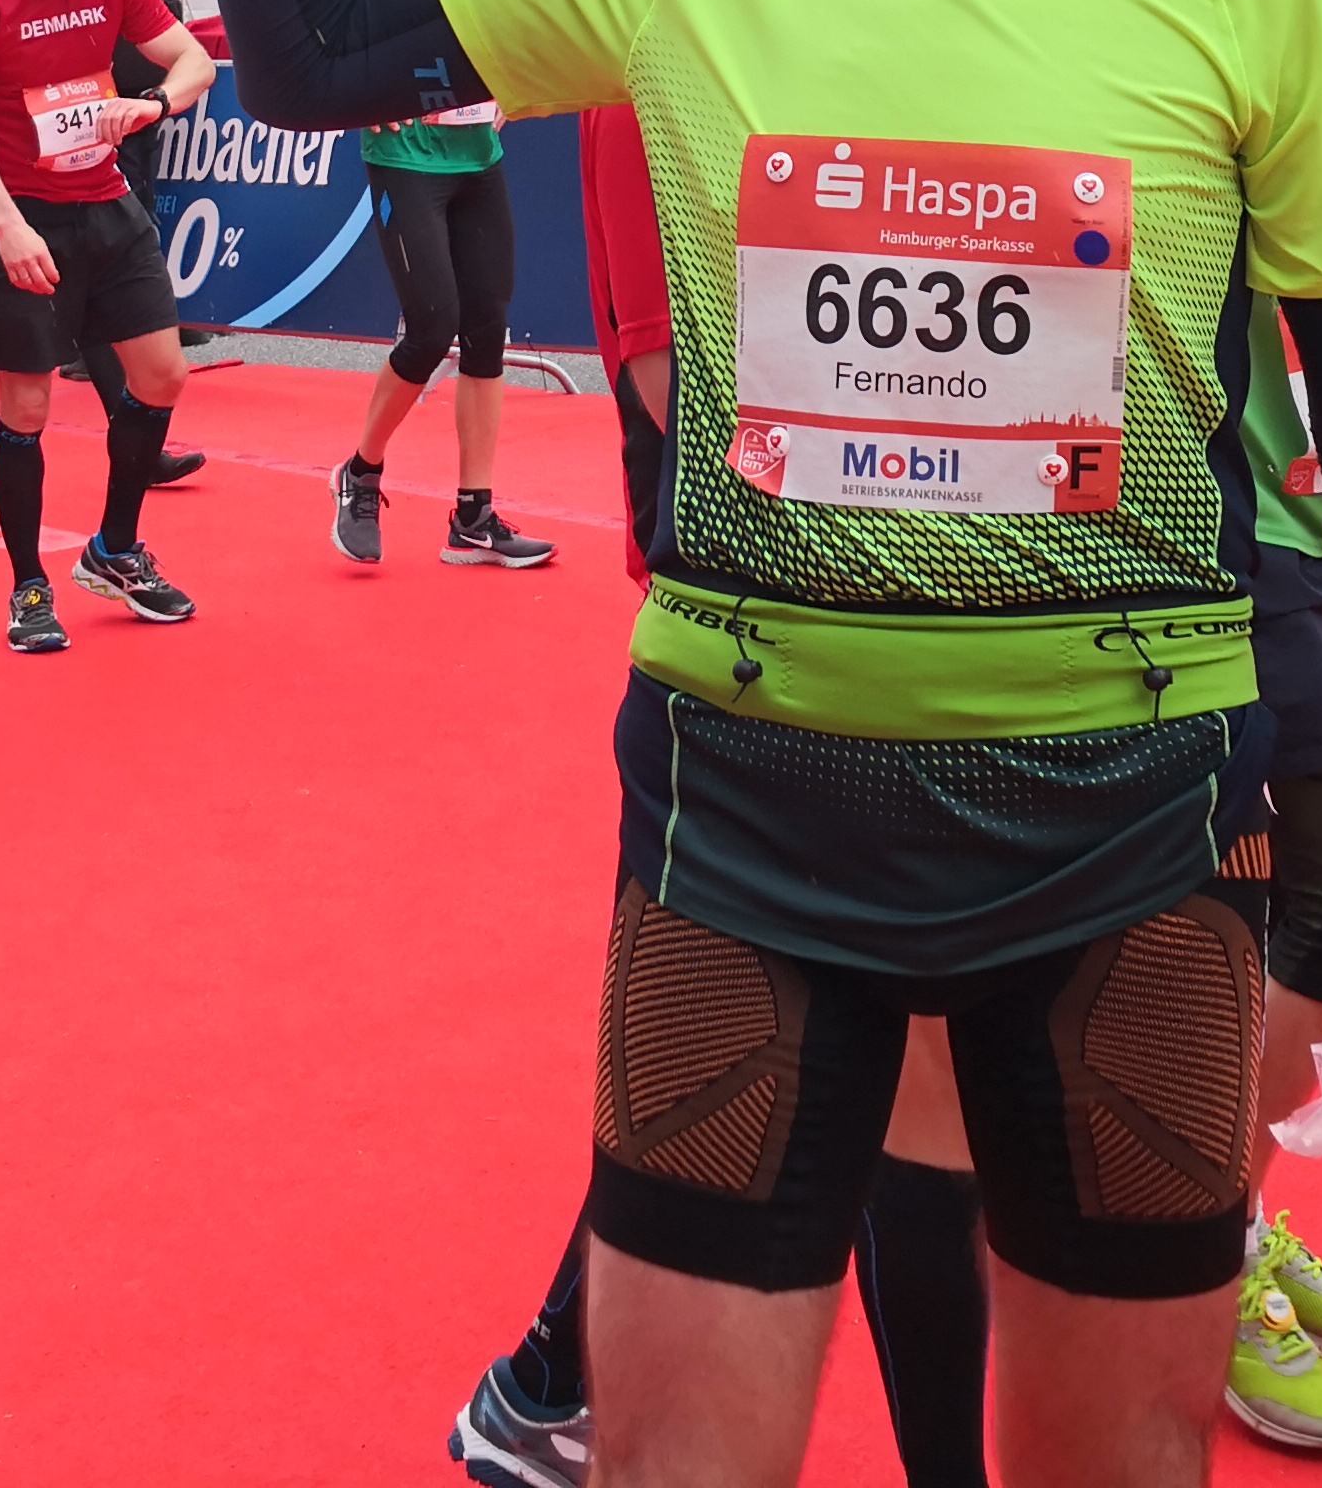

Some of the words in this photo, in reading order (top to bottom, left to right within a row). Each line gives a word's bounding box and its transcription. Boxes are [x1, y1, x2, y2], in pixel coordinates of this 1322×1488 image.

[20, 5, 107, 40] DENMARK
[62, 80, 99, 98] Haspa
[456, 107, 481, 117] Mobil
[69, 150, 96, 165] Mobil
[882, 166, 1038, 231] Haspa
[880, 229, 958, 252] Hamburger
[960, 234, 1035, 254] Sparkasse
[805, 263, 1032, 356] 6636
[835, 362, 988, 399] Fernando
[742, 459, 765, 473] CITY
[842, 442, 960, 484] Mobil
[1070, 445, 1102, 491] F
[841, 484, 984, 503] BETRIEBSKRANKENKASSE
